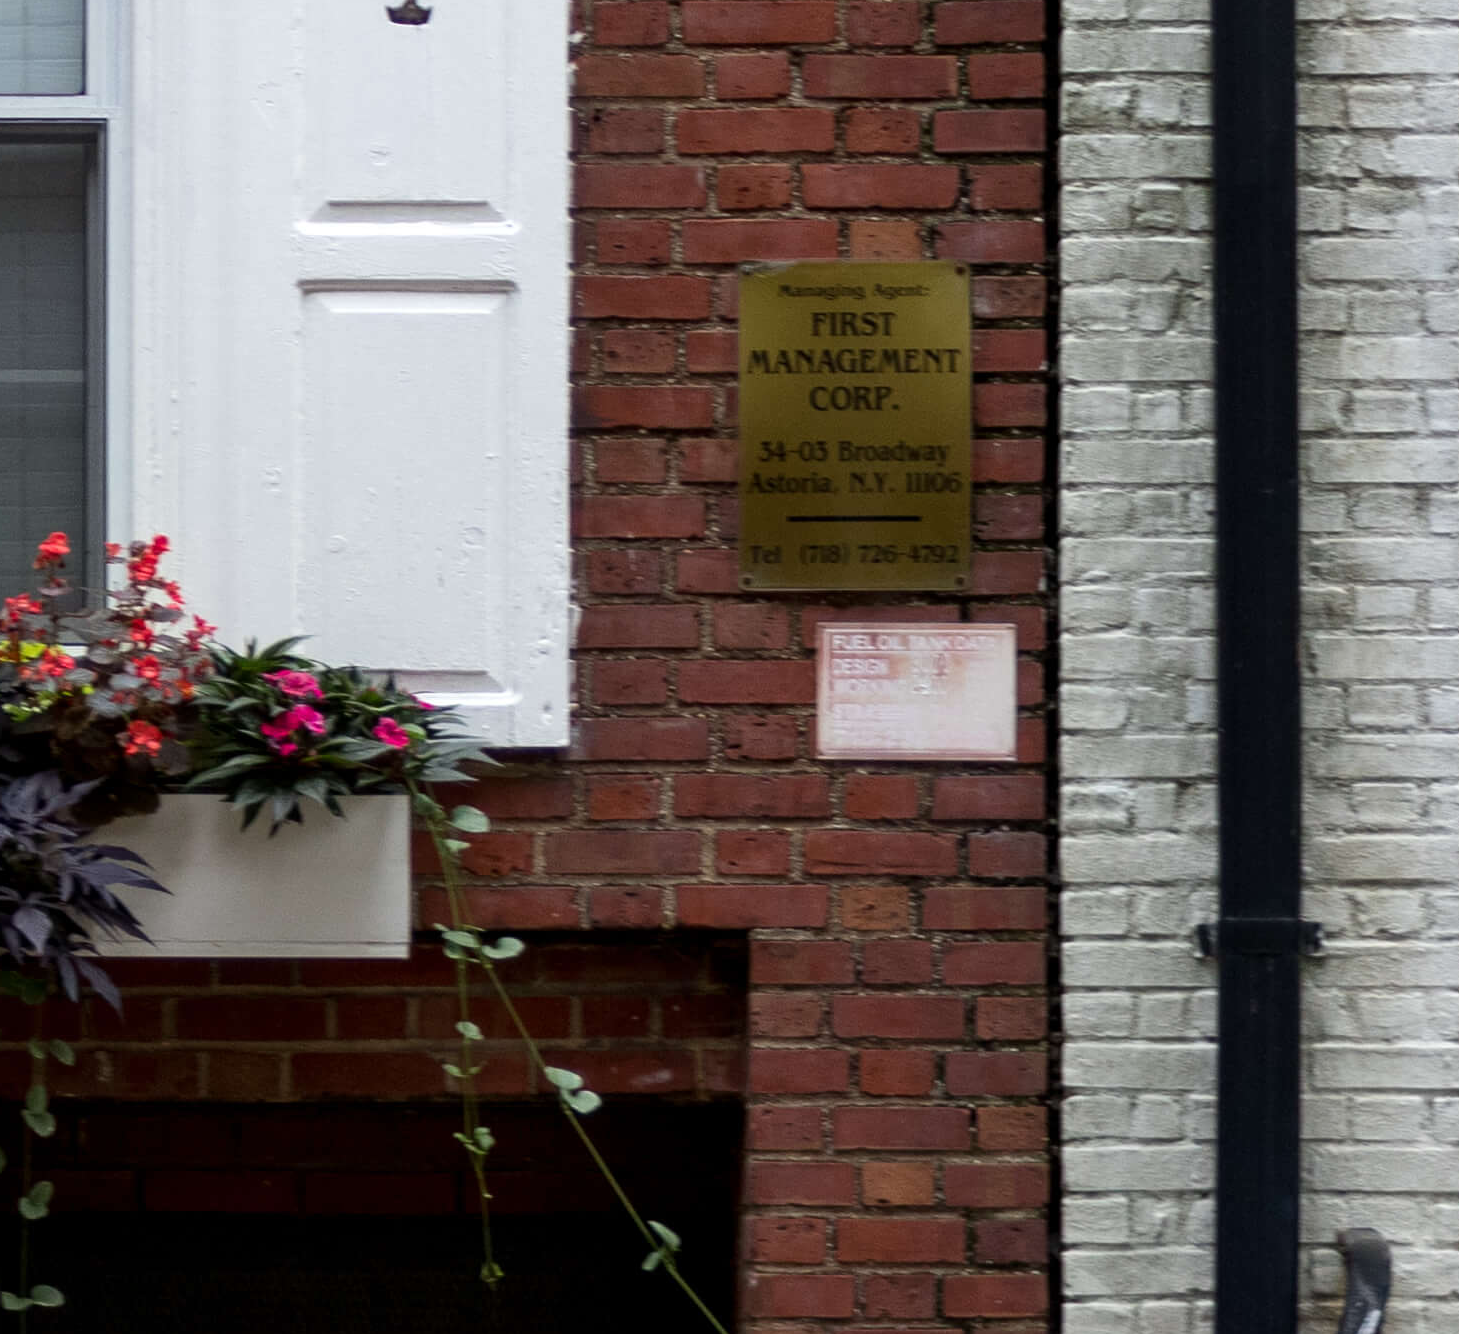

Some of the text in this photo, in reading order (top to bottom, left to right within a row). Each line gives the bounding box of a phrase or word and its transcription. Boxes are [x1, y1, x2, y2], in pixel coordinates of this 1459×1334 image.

[779, 284, 866, 299] Managing
[810, 312, 896, 336] FIRST
[747, 349, 961, 373] MANAGEMENT
[809, 386, 900, 411] CORP.
[759, 441, 949, 467] 34-03 Broadway
[849, 472, 898, 493] N.Y.
[905, 472, 962, 493] 11106
[799, 544, 848, 565] (718)
[856, 545, 959, 564] 726-4792
